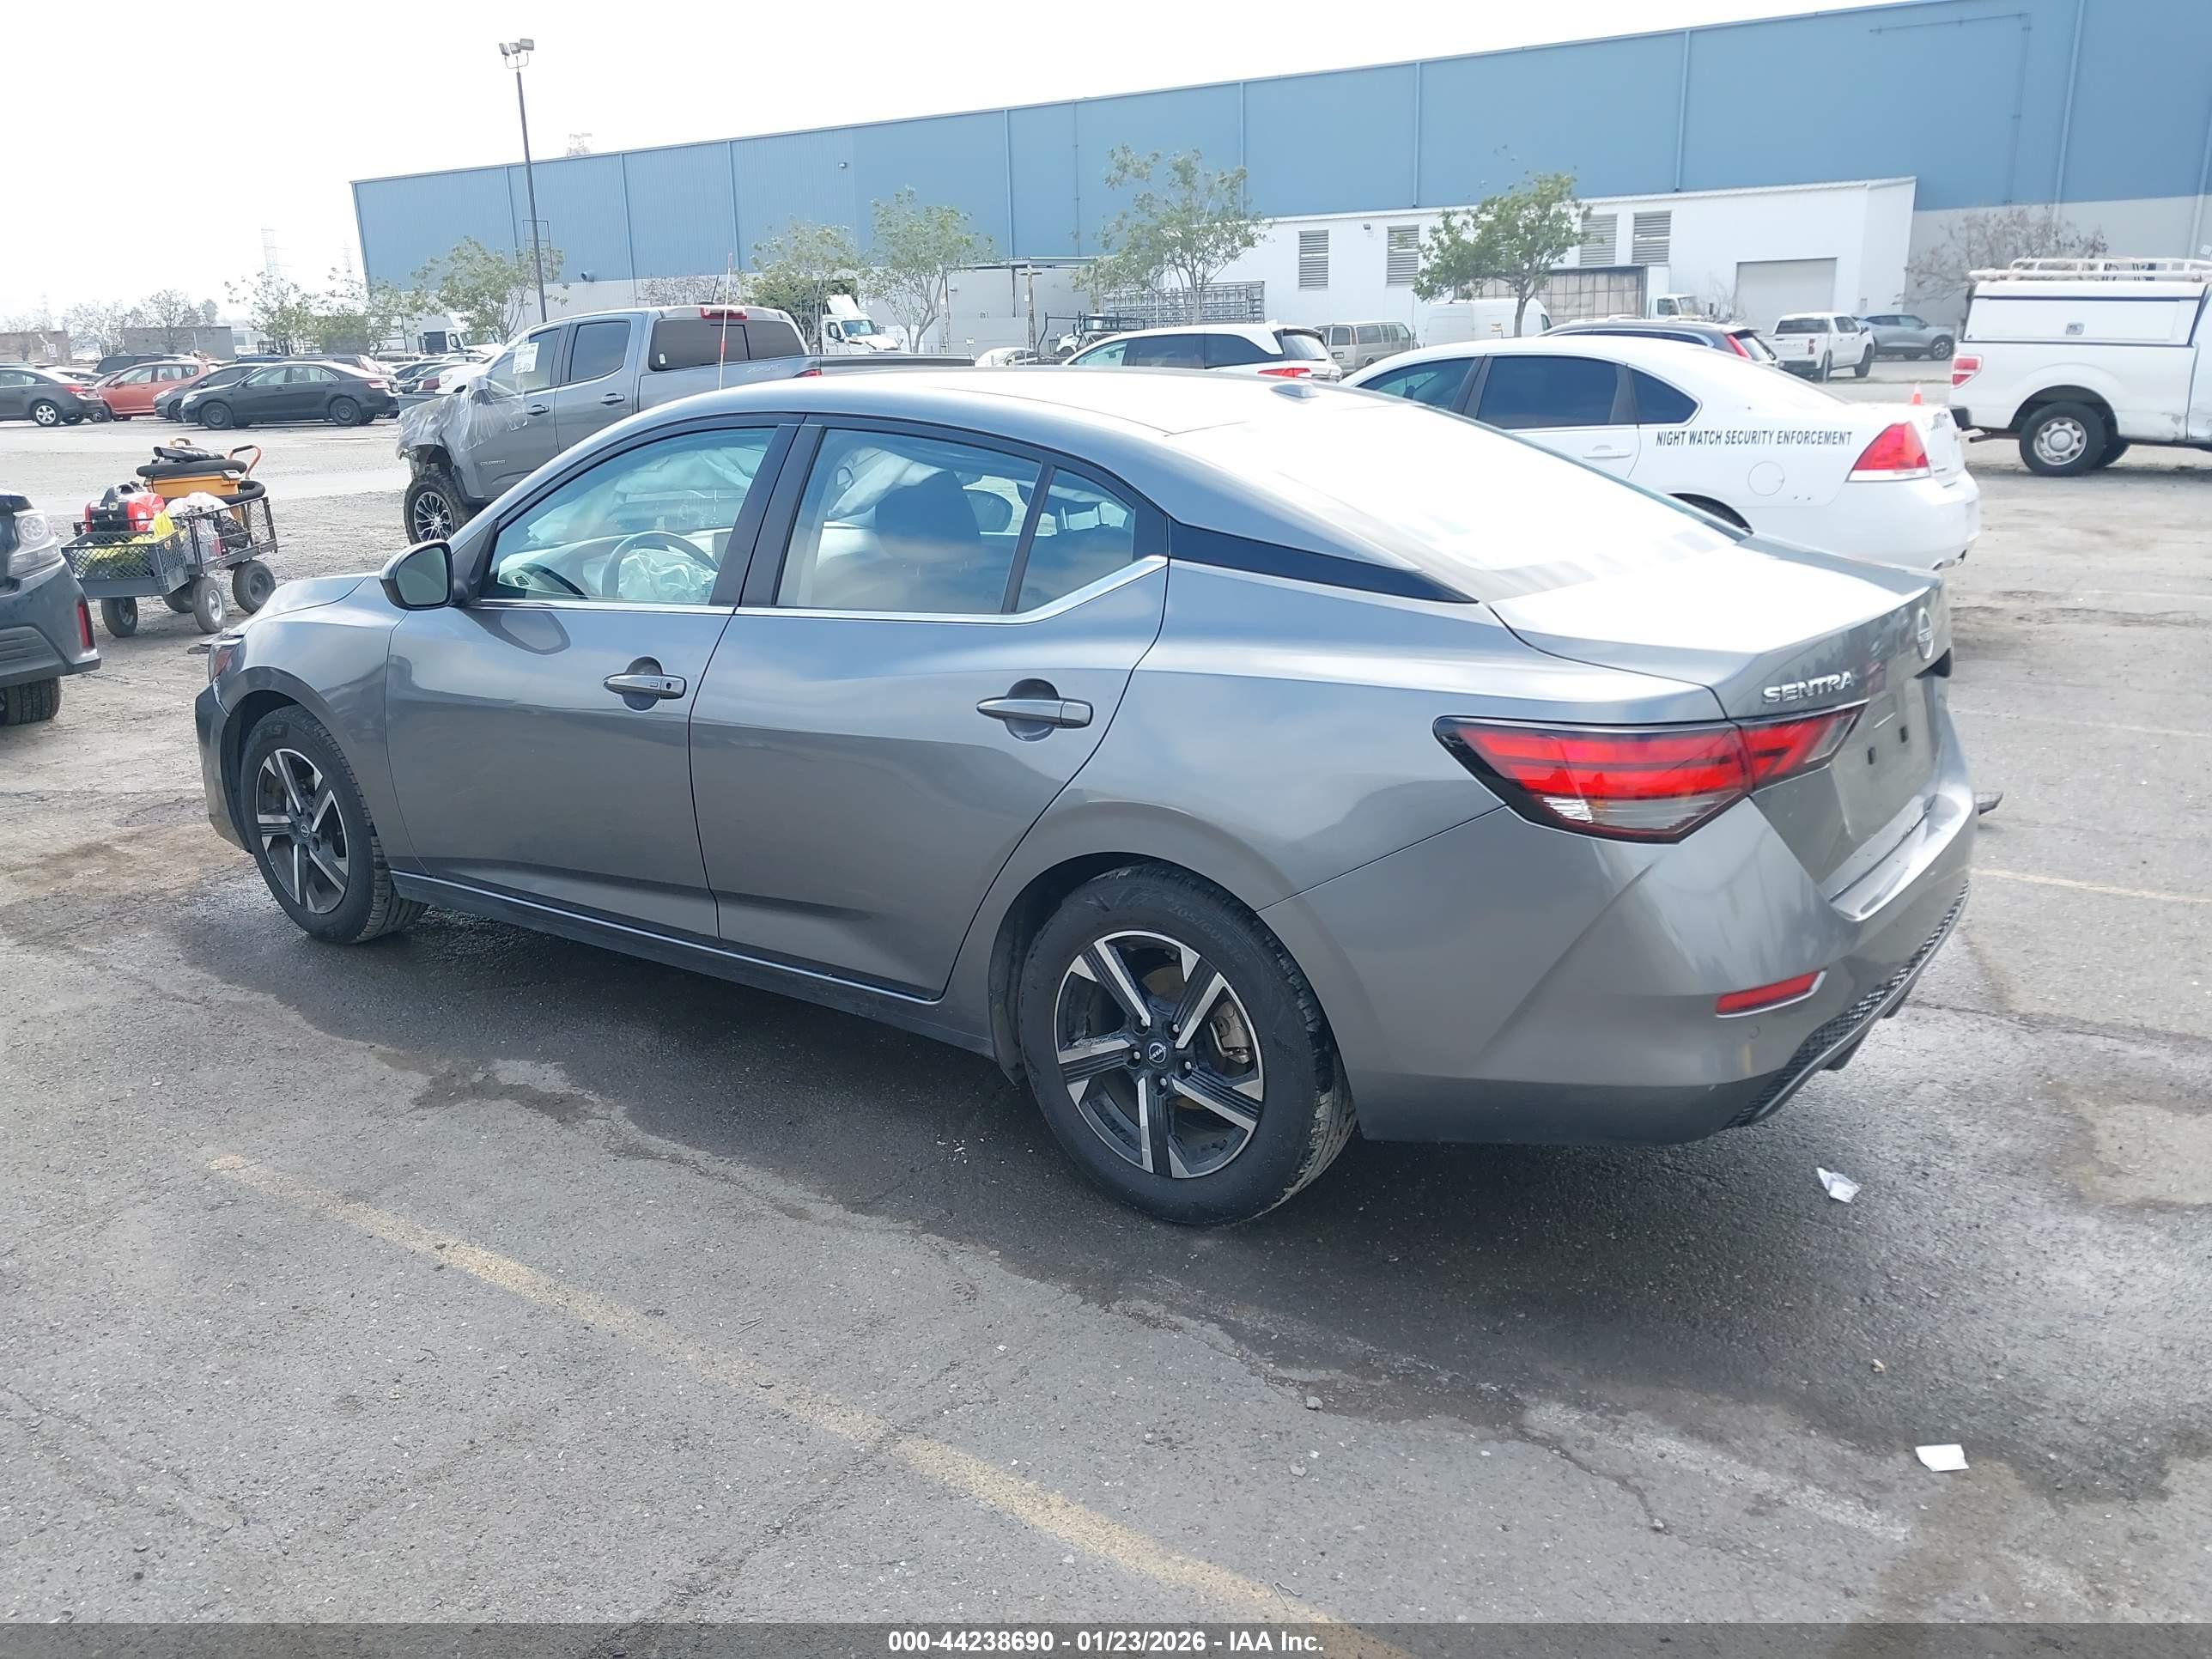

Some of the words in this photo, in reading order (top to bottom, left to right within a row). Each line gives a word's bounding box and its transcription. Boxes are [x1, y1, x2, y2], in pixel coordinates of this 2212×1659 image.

[1656, 431, 1686, 447] NIGHT
[1688, 430, 1723, 446] WATCH
[1724, 430, 1774, 445] SECURITY
[1777, 431, 1853, 446] ENFORCEMENT
[1763, 671, 1854, 703] SENTRA
